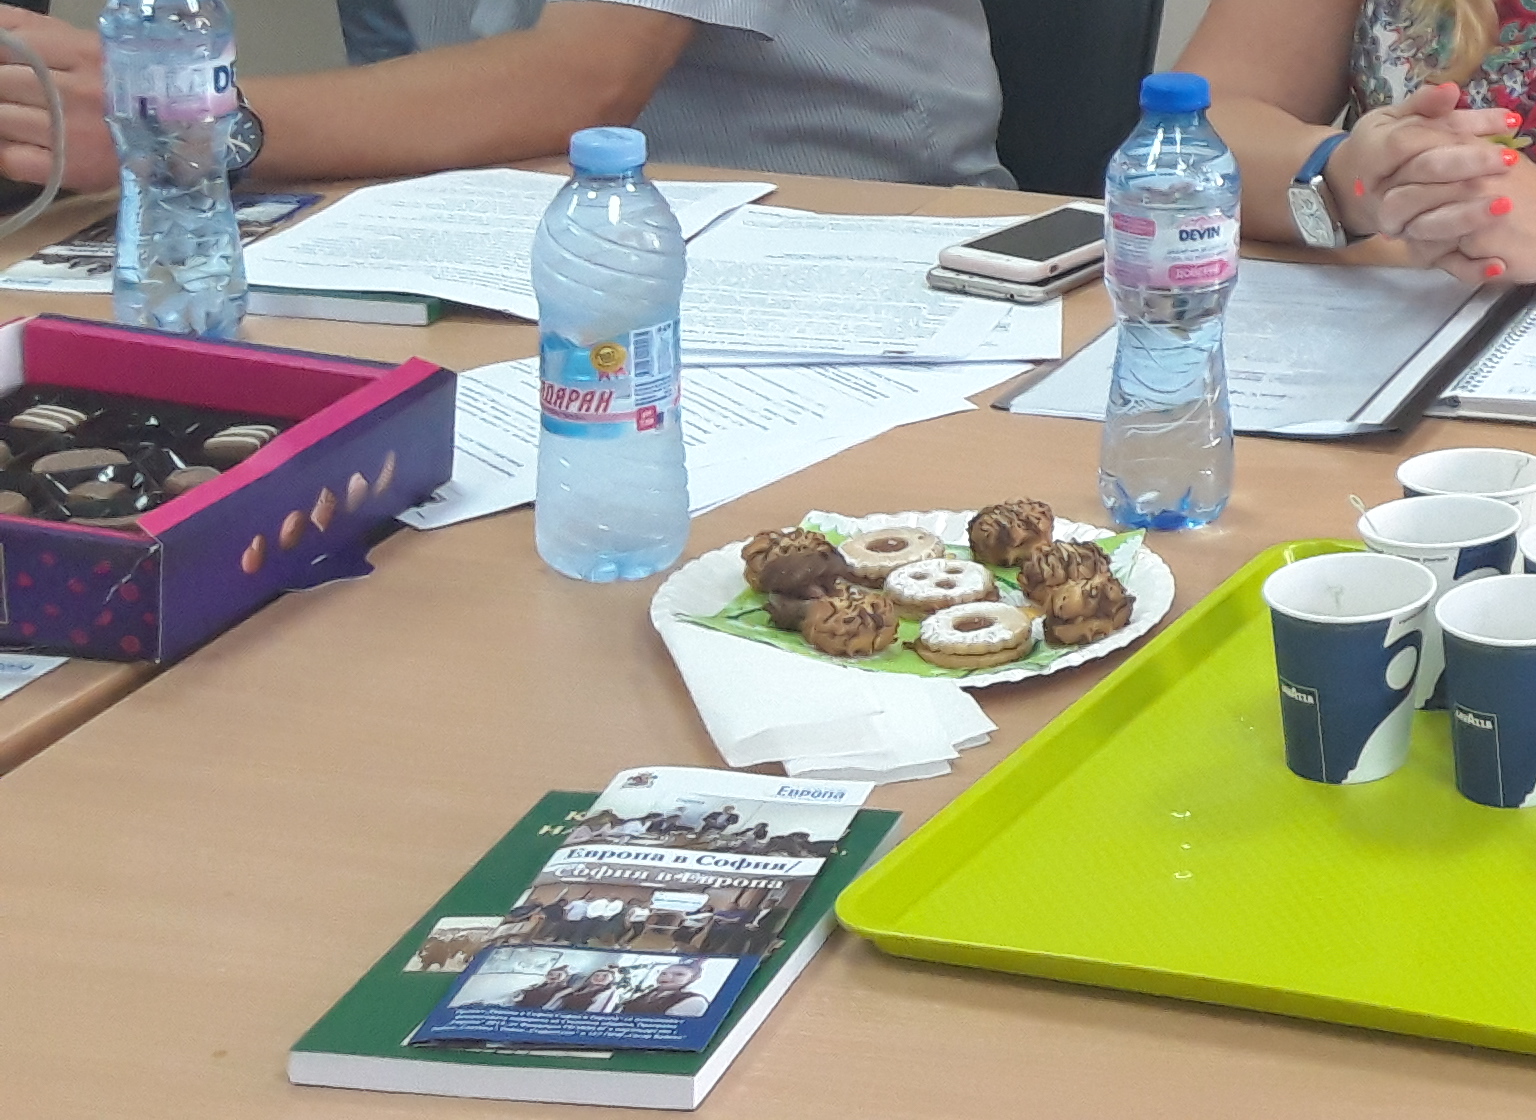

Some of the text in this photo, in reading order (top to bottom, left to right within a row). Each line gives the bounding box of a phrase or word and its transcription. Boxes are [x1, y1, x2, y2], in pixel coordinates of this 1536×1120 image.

[1179, 226, 1220, 241] DEVIN
[566, 848, 802, 873] Европа в София/
[555, 864, 650, 880] София
